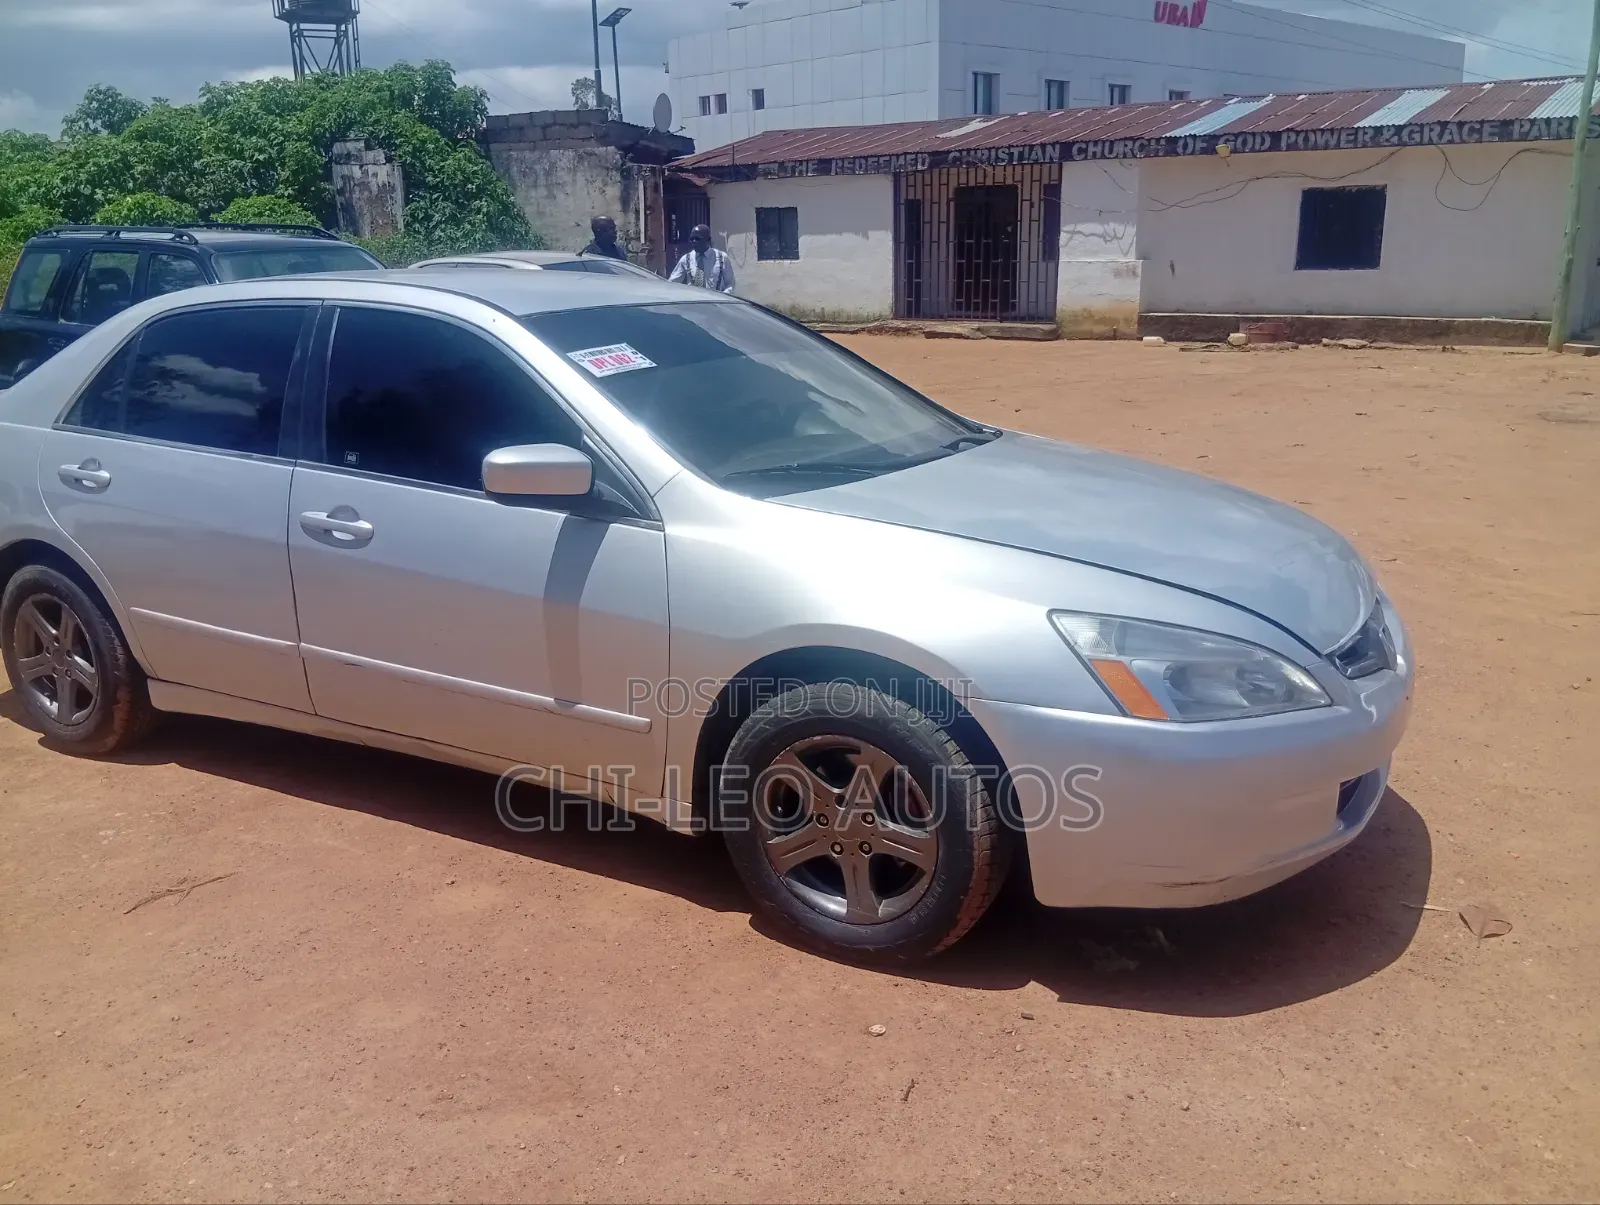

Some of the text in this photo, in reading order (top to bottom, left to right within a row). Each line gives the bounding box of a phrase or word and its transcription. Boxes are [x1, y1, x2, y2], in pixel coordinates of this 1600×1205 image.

[1154, 1, 1189, 27] UBA
[784, 160, 818, 177] THE
[831, 154, 930, 175] REDEEMED
[948, 144, 1060, 168] CHRISTIAN
[1072, 138, 1166, 160] CHURCH
[1177, 136, 1208, 155] OF
[1218, 133, 1270, 152] GOD
[1281, 127, 1375, 150] POWER
[1401, 119, 1499, 145] GRACE
